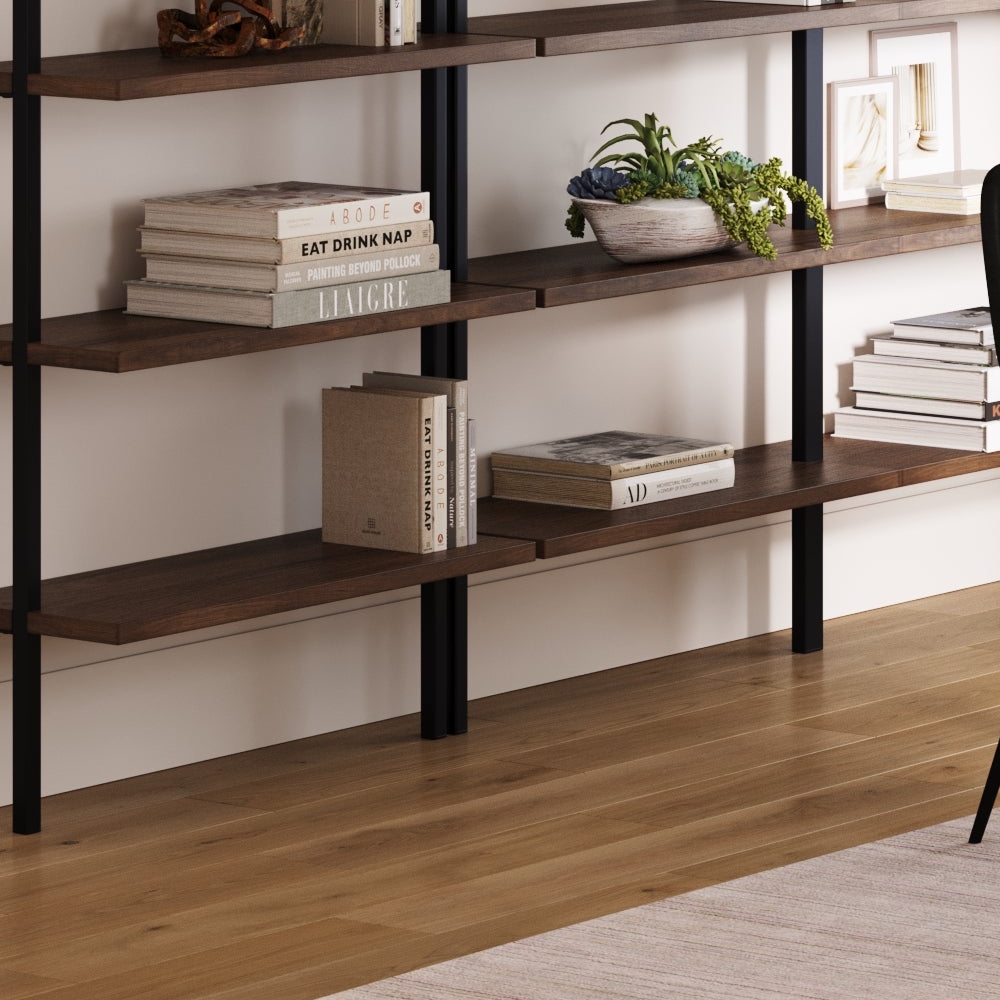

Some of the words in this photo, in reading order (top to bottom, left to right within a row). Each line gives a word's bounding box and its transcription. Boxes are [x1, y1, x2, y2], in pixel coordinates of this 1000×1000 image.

[330, 203, 390, 225] ABODE
[301, 240, 329, 257] EAT
[333, 233, 379, 252] DRINK
[382, 229, 412, 246] NAP
[307, 264, 346, 281] PAINTING
[348, 259, 381, 276] BEYOND
[384, 253, 421, 271] POLLOCK
[319, 280, 409, 319] LIAIGRE
[622, 482, 647, 505] AD
